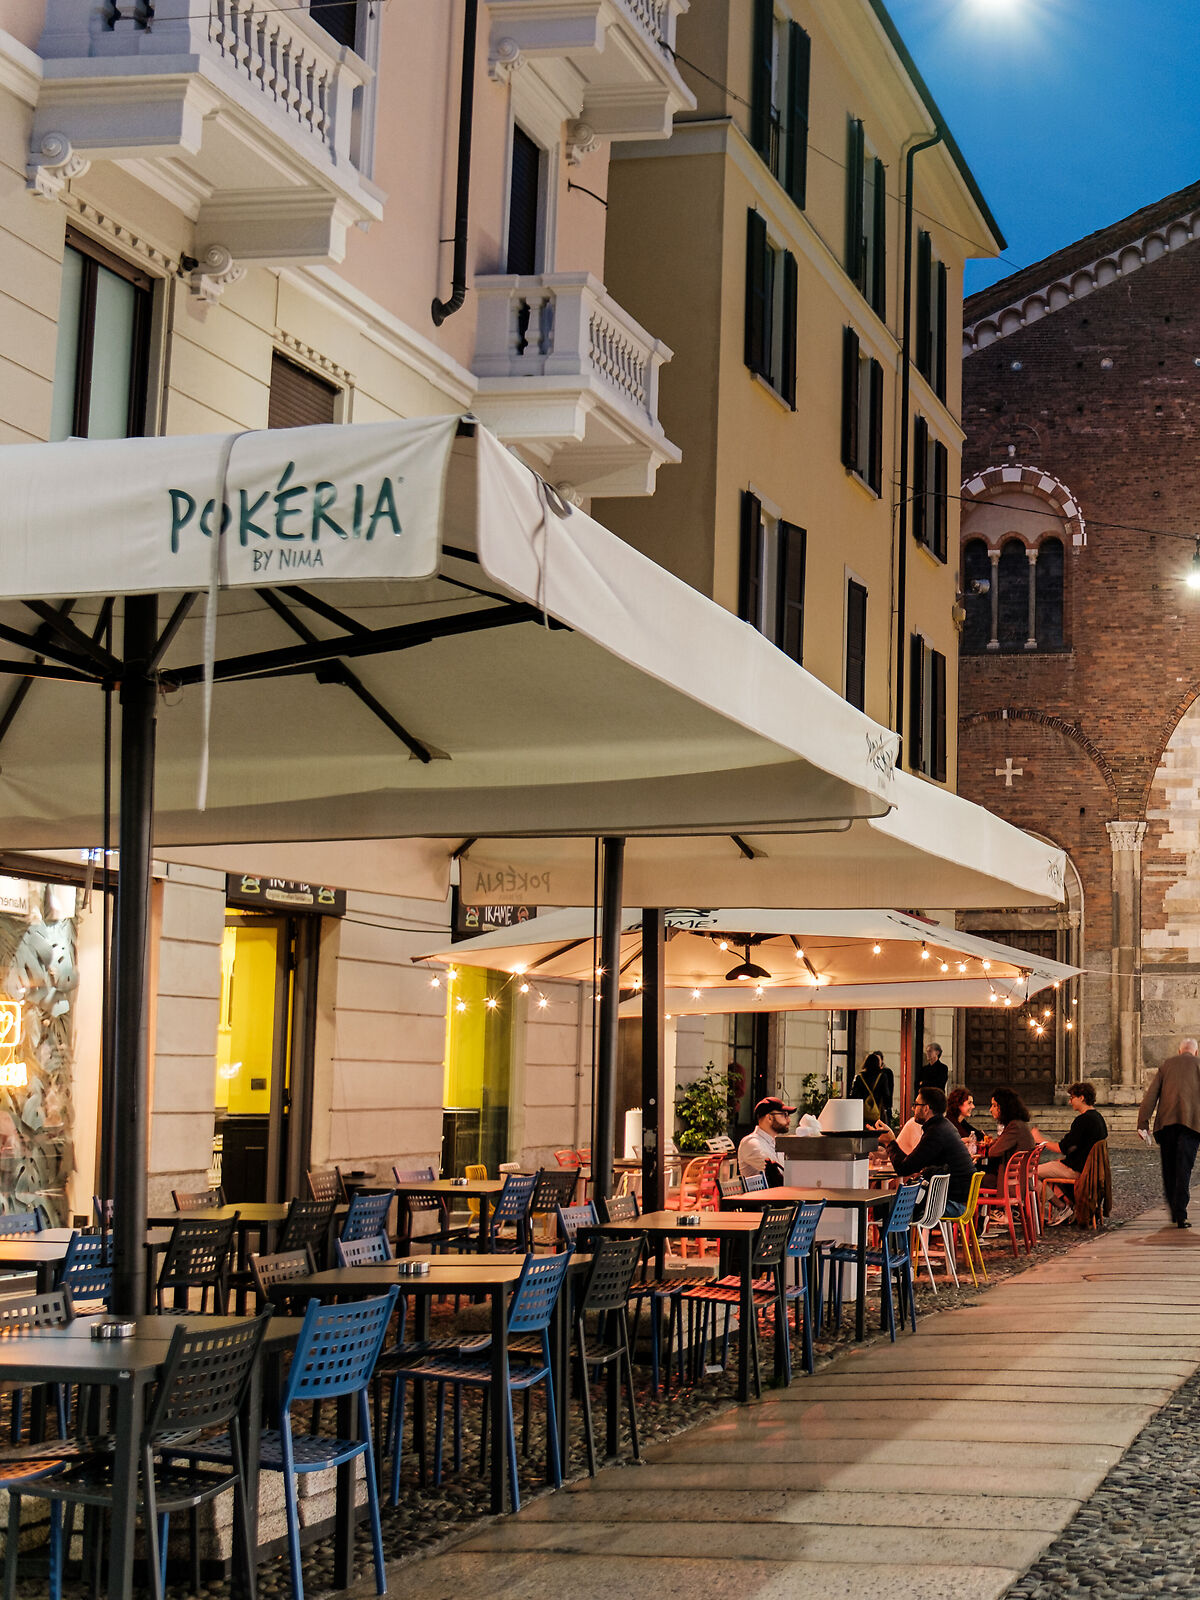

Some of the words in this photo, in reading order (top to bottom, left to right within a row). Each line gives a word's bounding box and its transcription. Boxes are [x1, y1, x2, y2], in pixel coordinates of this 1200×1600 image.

[168, 461, 402, 554] POKÉRIA
[252, 550, 273, 572] BY
[278, 548, 324, 570] NIMA
